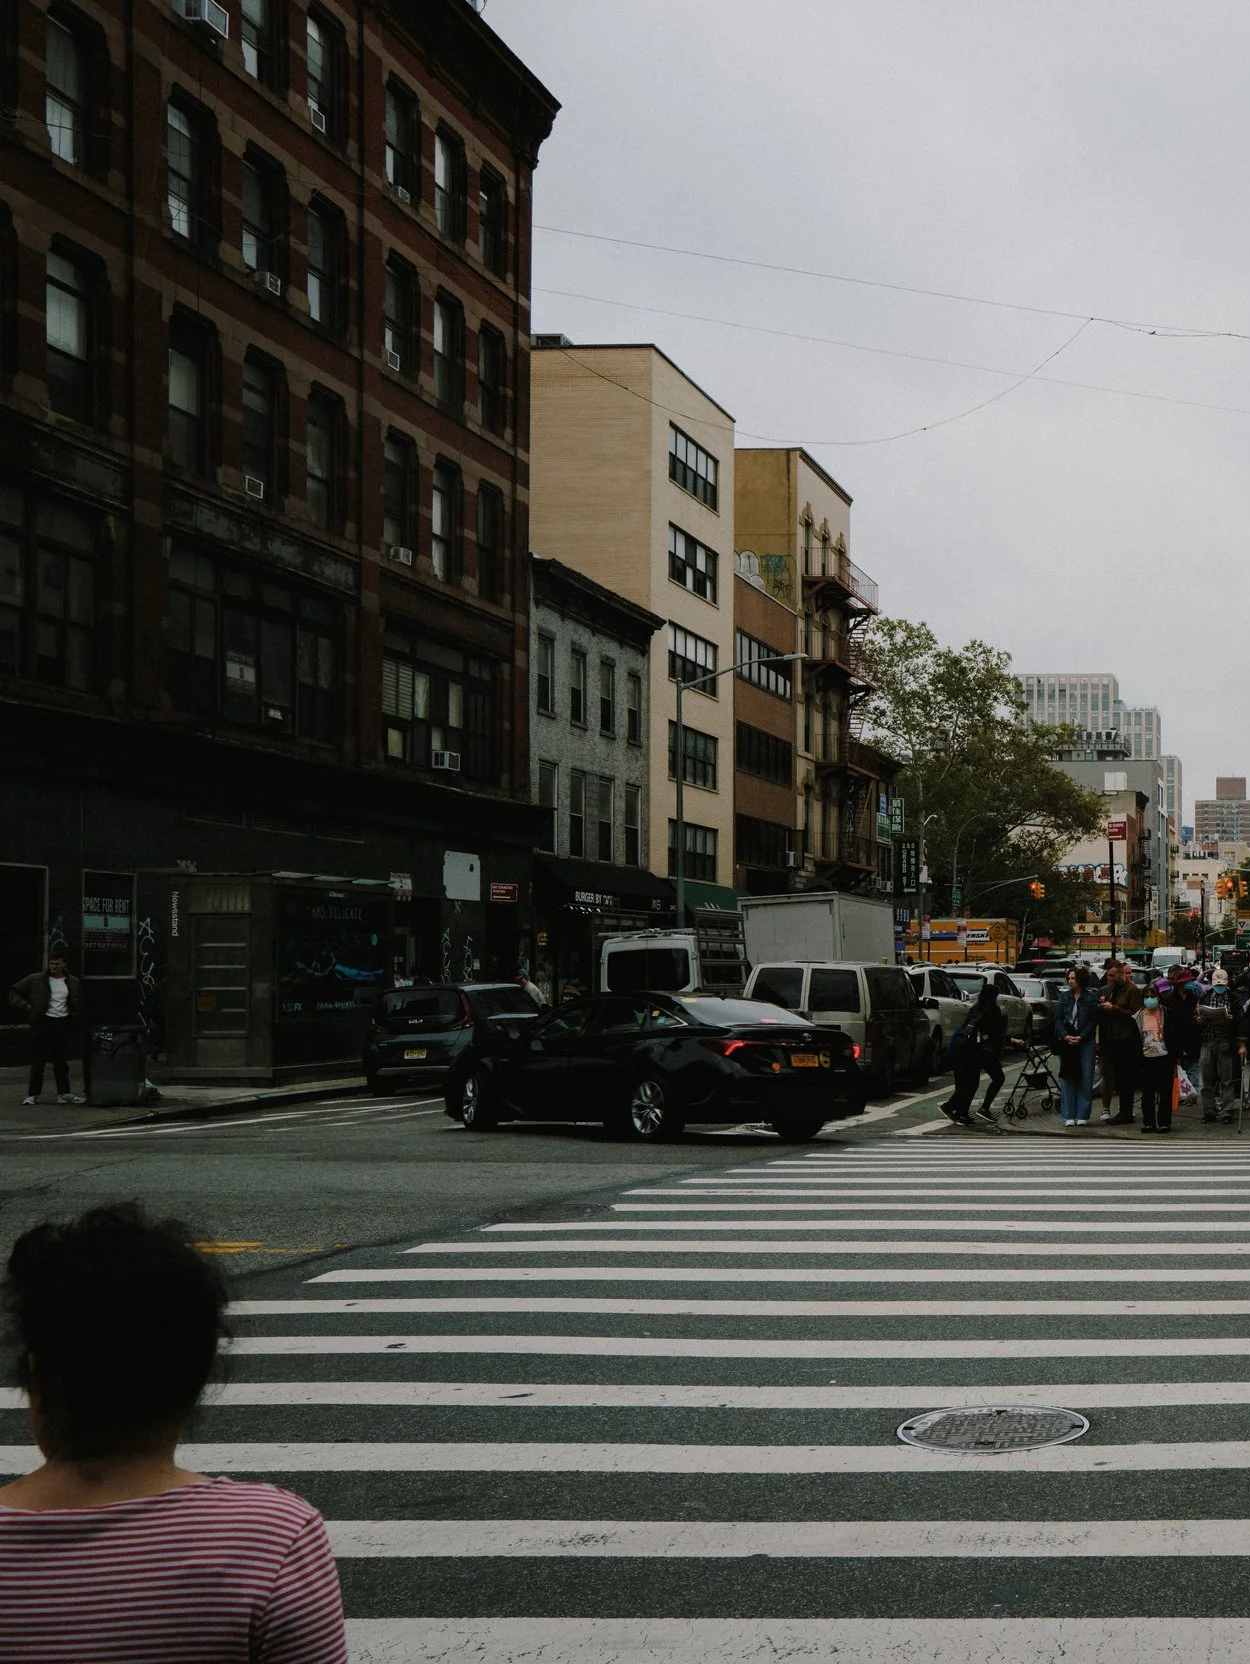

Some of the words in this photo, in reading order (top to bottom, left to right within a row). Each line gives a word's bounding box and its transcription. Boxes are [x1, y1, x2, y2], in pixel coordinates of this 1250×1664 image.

[82, 896, 101, 913] SPACE
[102, 897, 113, 914] FOR
[114, 898, 130, 915] RENT
[575, 890, 594, 903] BURGER
[595, 893, 602, 904] BY
[171, 890, 180, 937] Newsstand
